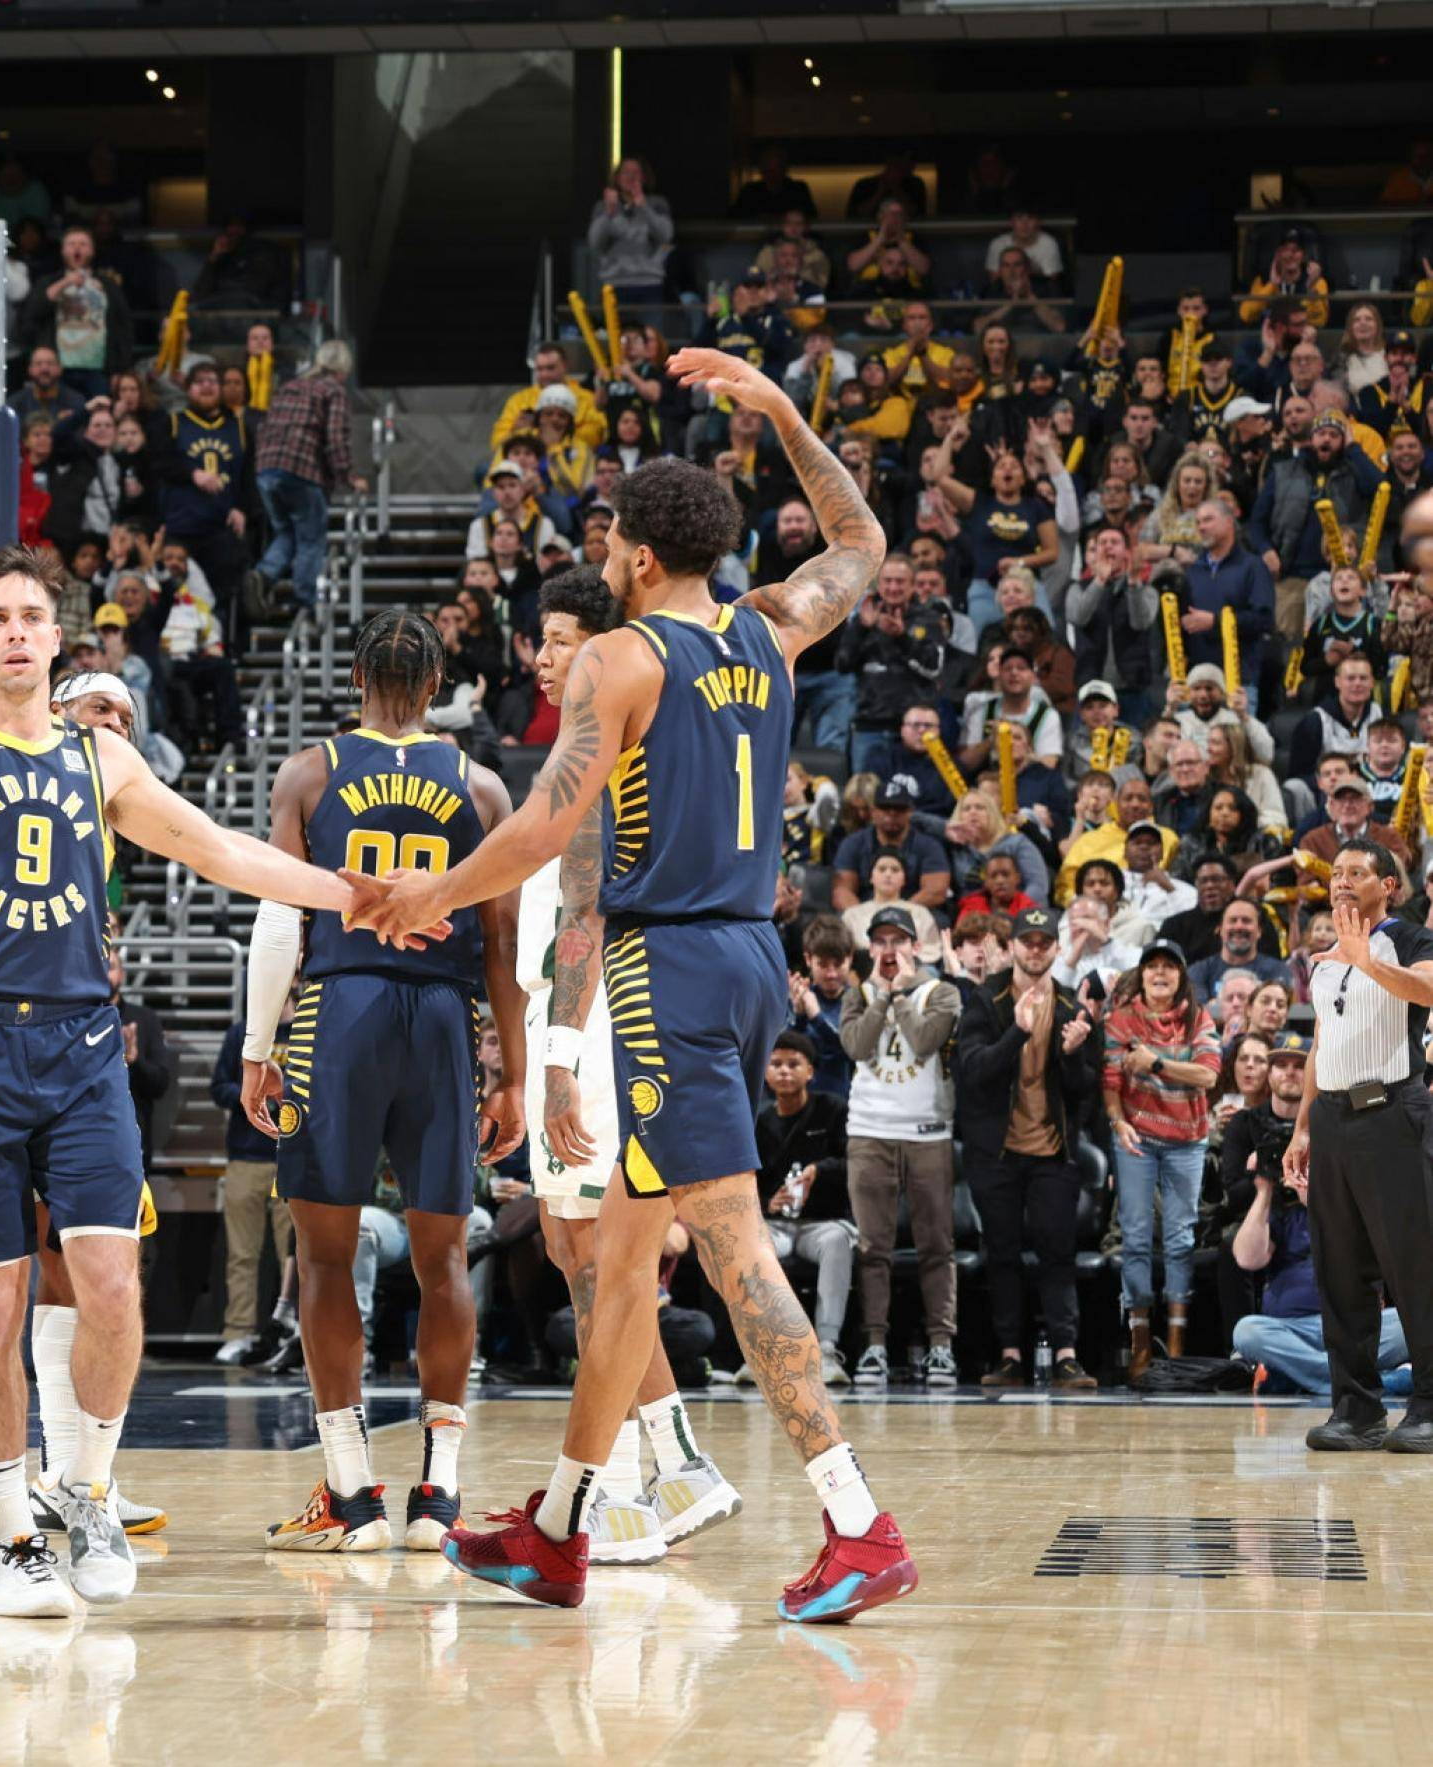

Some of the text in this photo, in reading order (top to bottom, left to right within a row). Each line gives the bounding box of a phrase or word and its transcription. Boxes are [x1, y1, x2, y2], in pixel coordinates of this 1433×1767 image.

[694, 665, 770, 712] TOPPIN
[337, 773, 463, 825] MATHURIN
[735, 734, 754, 850] 1
[15, 813, 53, 887] 9
[885, 1027, 902, 1062] 4
